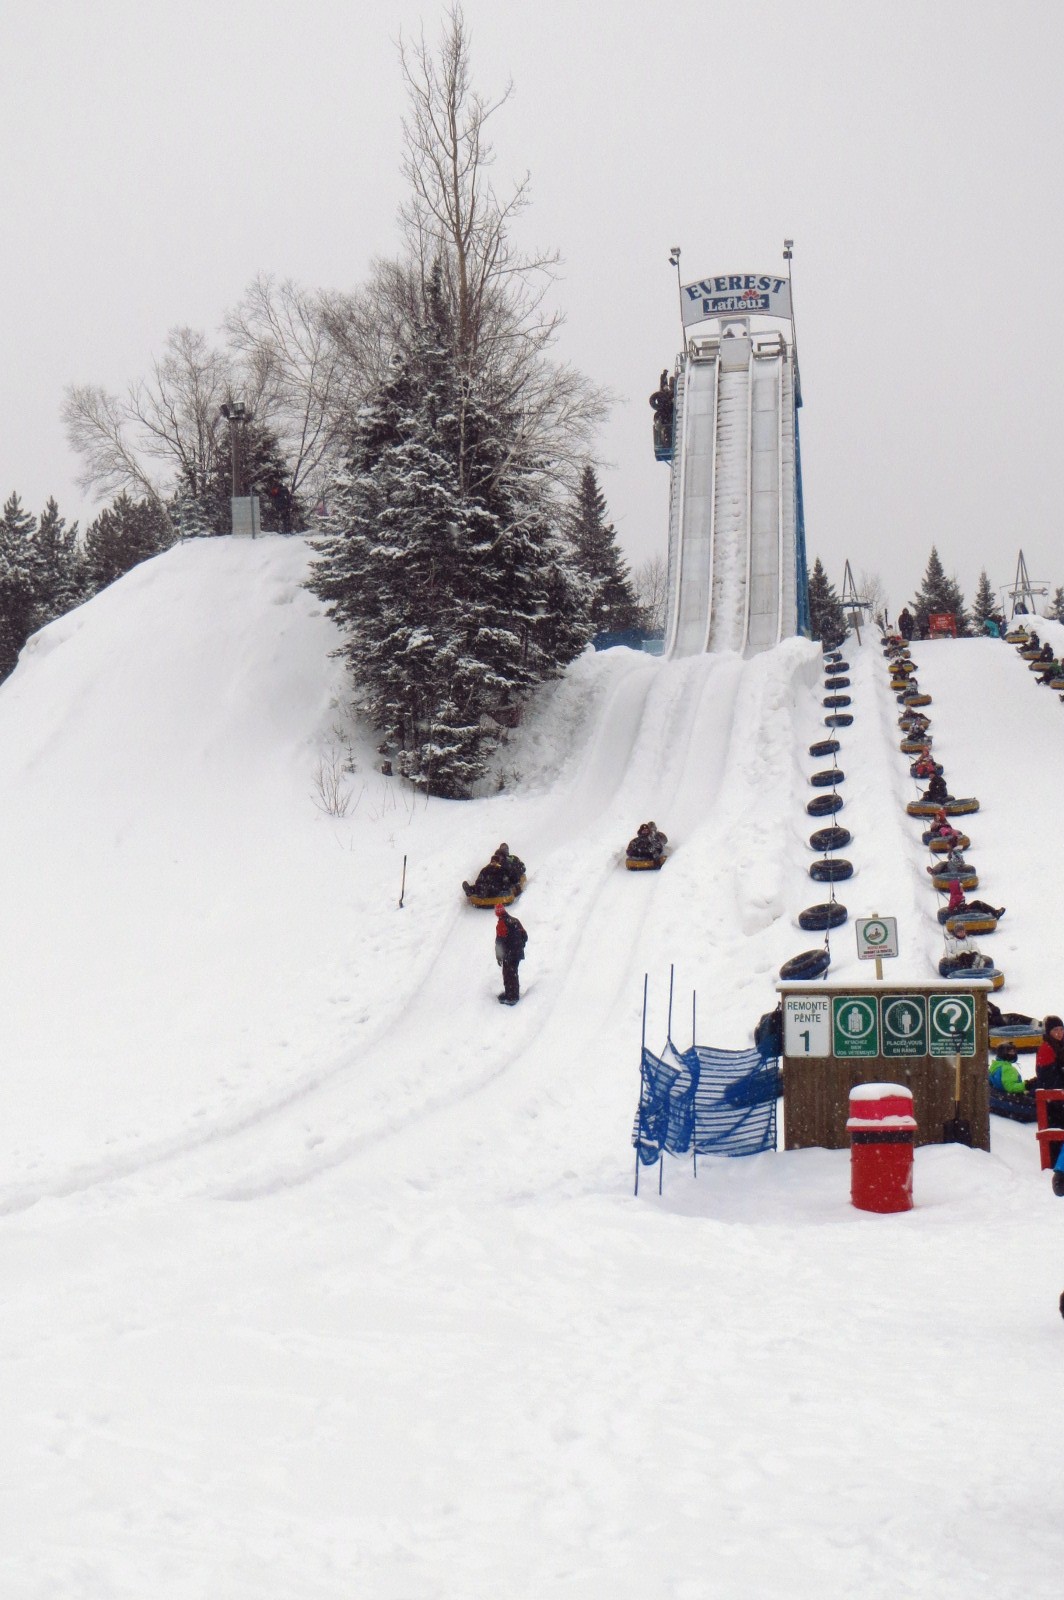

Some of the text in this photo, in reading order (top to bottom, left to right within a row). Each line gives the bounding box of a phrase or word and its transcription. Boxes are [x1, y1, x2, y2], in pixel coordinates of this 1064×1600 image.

[685, 275, 785, 301] EVEREST
[707, 298, 765, 311] Lafleur
[787, 1001, 828, 1010] REMONTE
[794, 1014, 821, 1022] PENTE
[799, 1030, 809, 1051] 1
